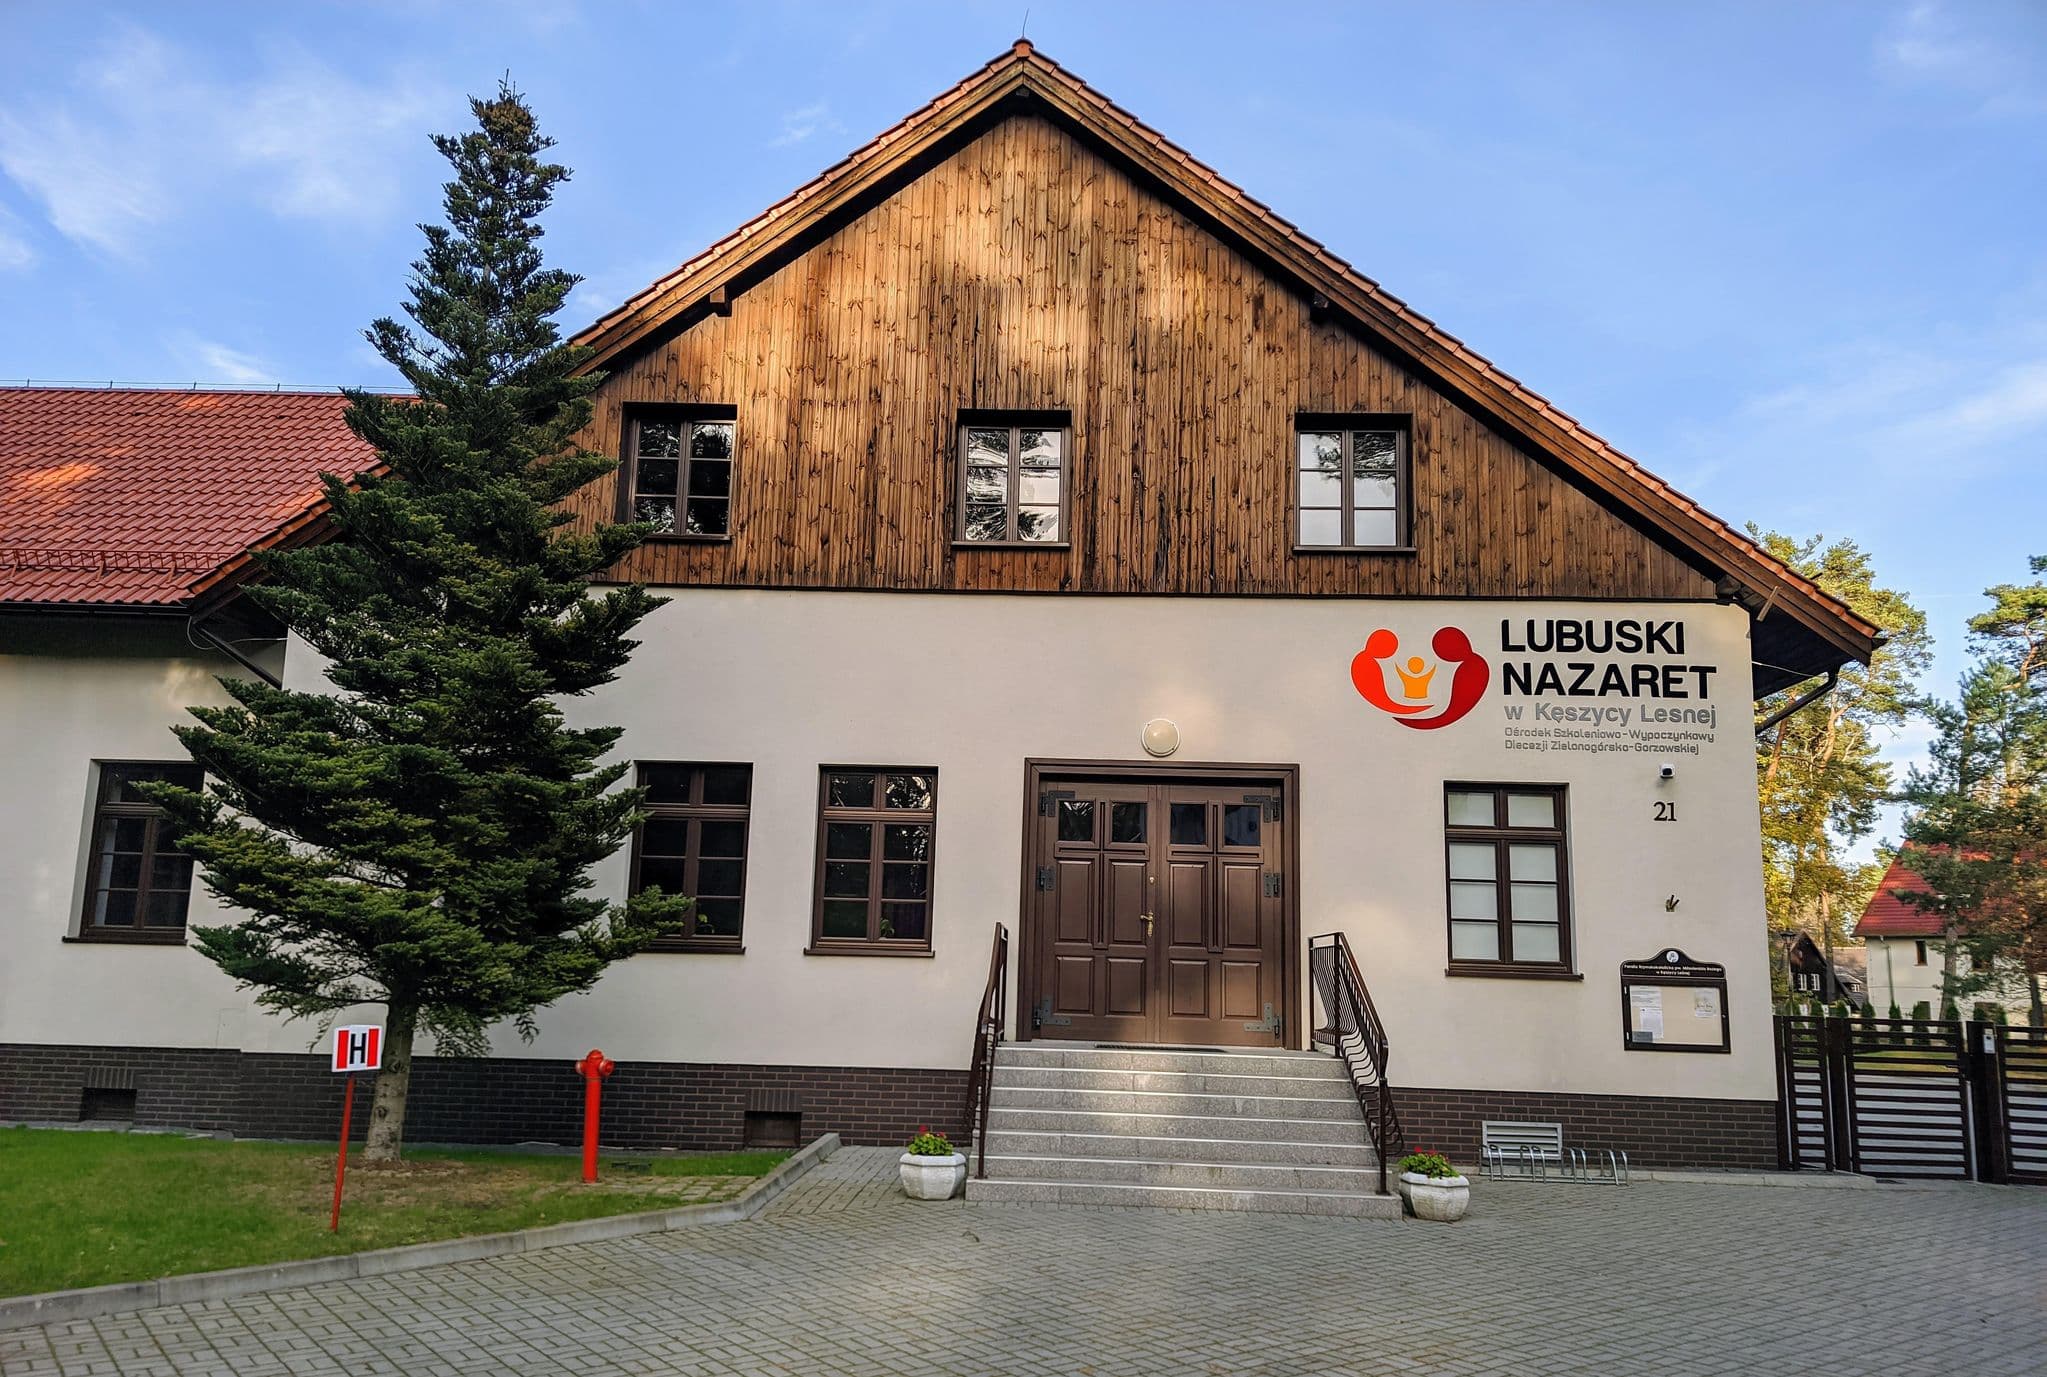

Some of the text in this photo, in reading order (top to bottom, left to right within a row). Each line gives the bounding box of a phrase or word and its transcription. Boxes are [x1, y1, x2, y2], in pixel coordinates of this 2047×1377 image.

[1501, 619, 1685, 655] LUBUSKI
[1503, 662, 1717, 699] NAZARET
[1503, 702, 1717, 729] w Kęszycy Lesnej
[1504, 726, 1552, 737] Ośrodek
[1504, 740, 1549, 752] Diecezji
[1653, 801, 1678, 822] 21
[349, 1032, 368, 1065] H
